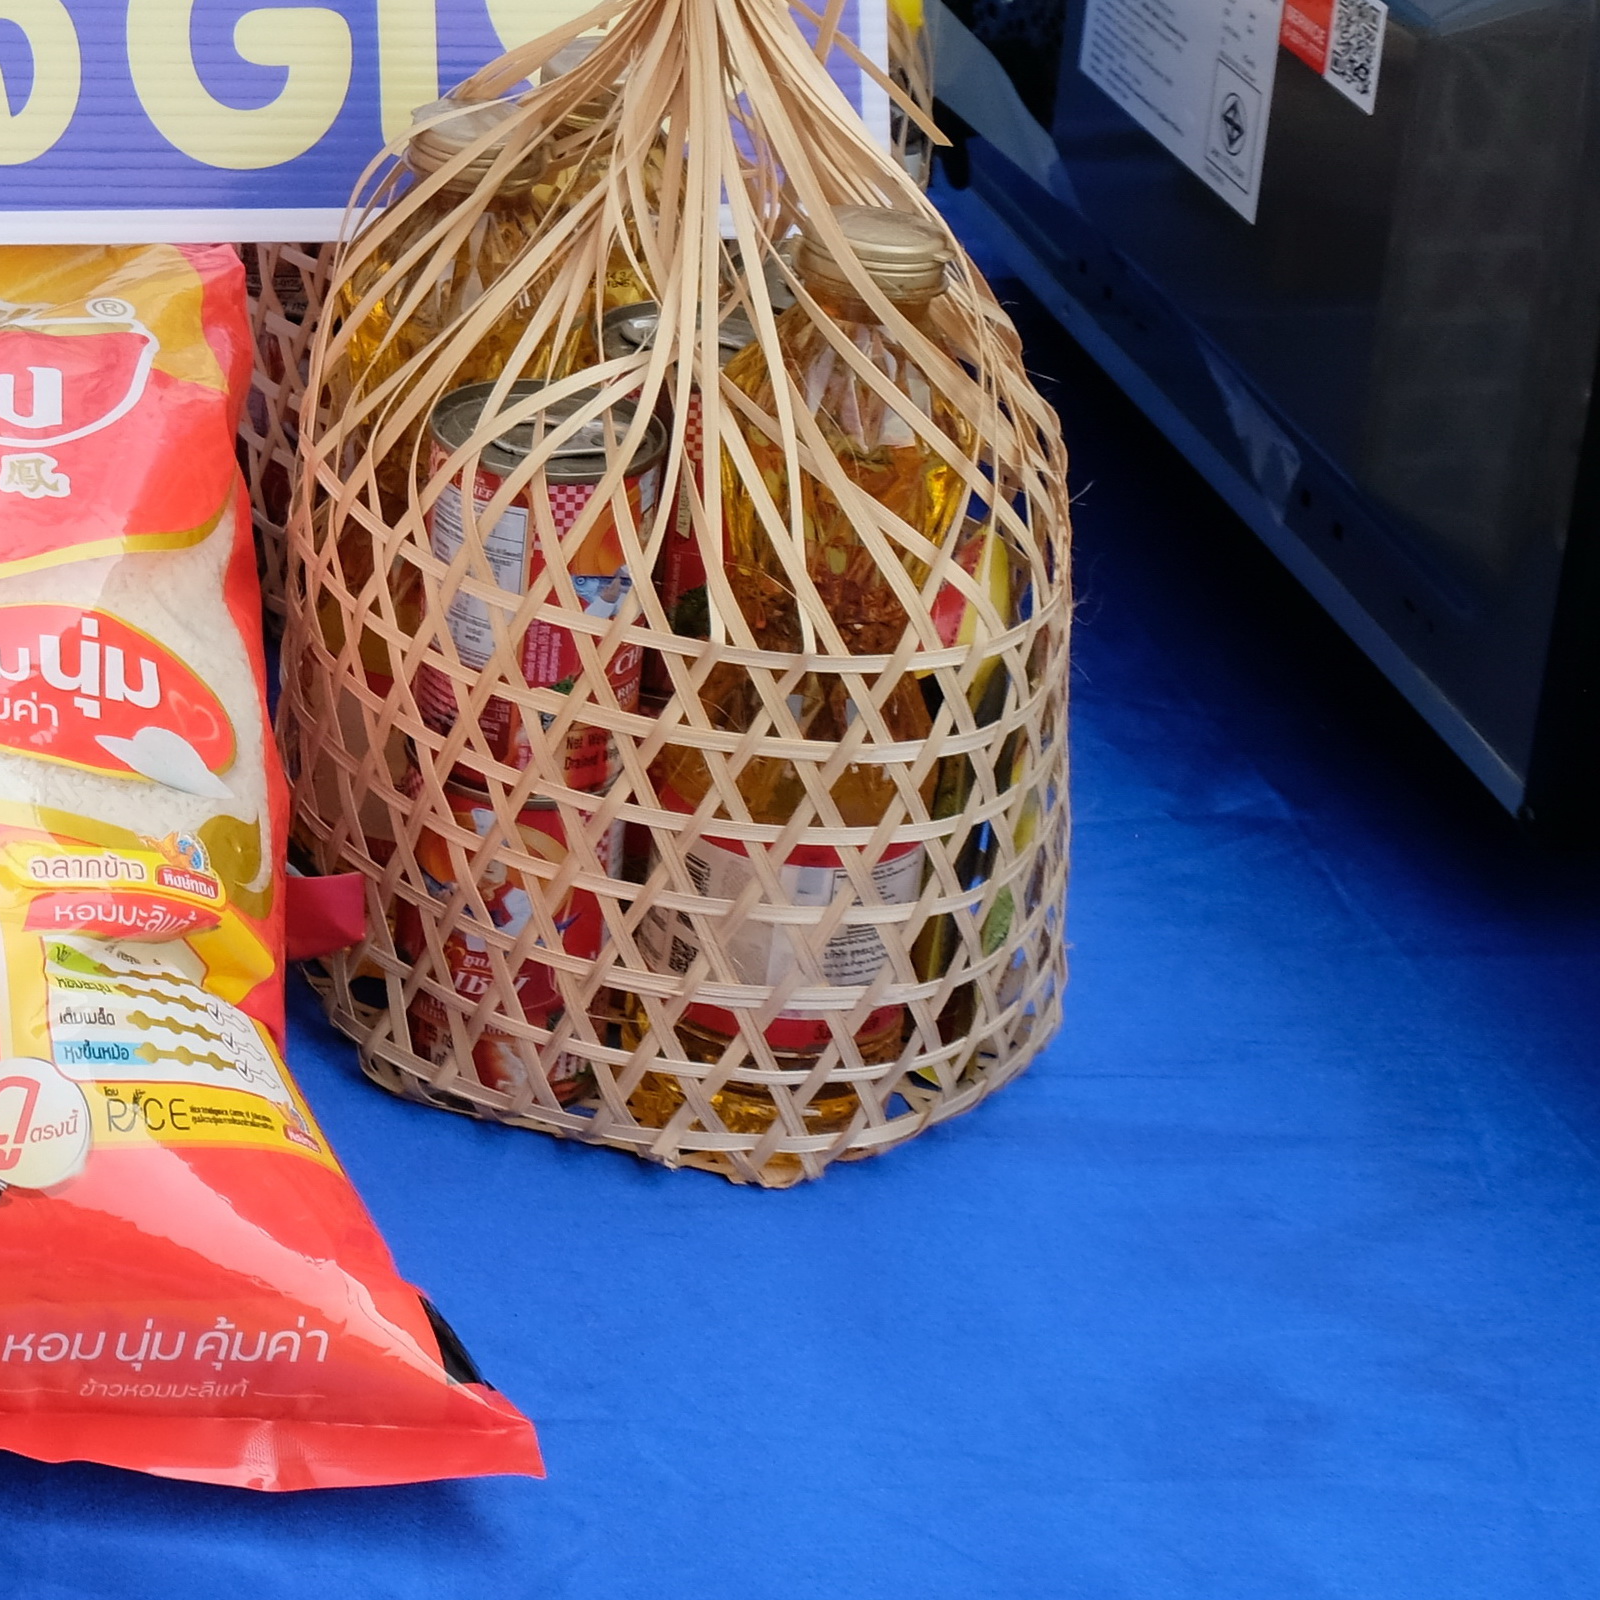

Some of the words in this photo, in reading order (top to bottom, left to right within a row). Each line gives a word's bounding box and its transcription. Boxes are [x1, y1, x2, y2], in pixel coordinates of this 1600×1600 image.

[31, 854, 145, 880] ฉลากข้าว
[0, 1330, 105, 1364] หอม
[115, 1317, 186, 1372] นุ่ม
[193, 1315, 331, 1372] คุ้มค่า
[78, 1378, 251, 1399] ข้าวหอมมะลิแท้
